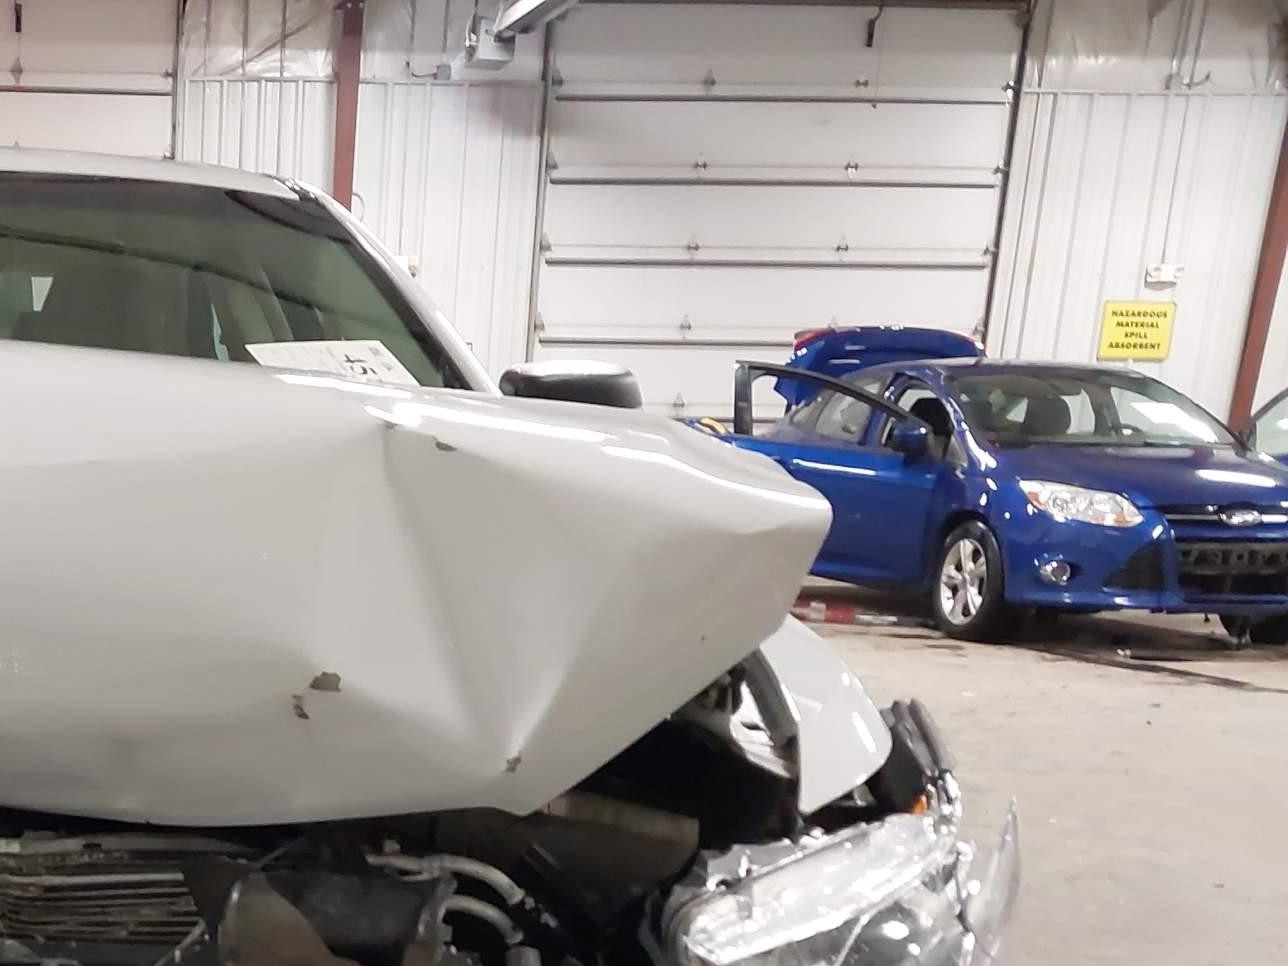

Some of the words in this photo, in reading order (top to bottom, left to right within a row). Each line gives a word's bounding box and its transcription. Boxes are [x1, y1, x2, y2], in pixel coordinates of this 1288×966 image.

[1111, 310, 1168, 318] HAZARDOUS
[1124, 331, 1148, 339] SPILL
[1108, 341, 1160, 350] ABSORBENT
